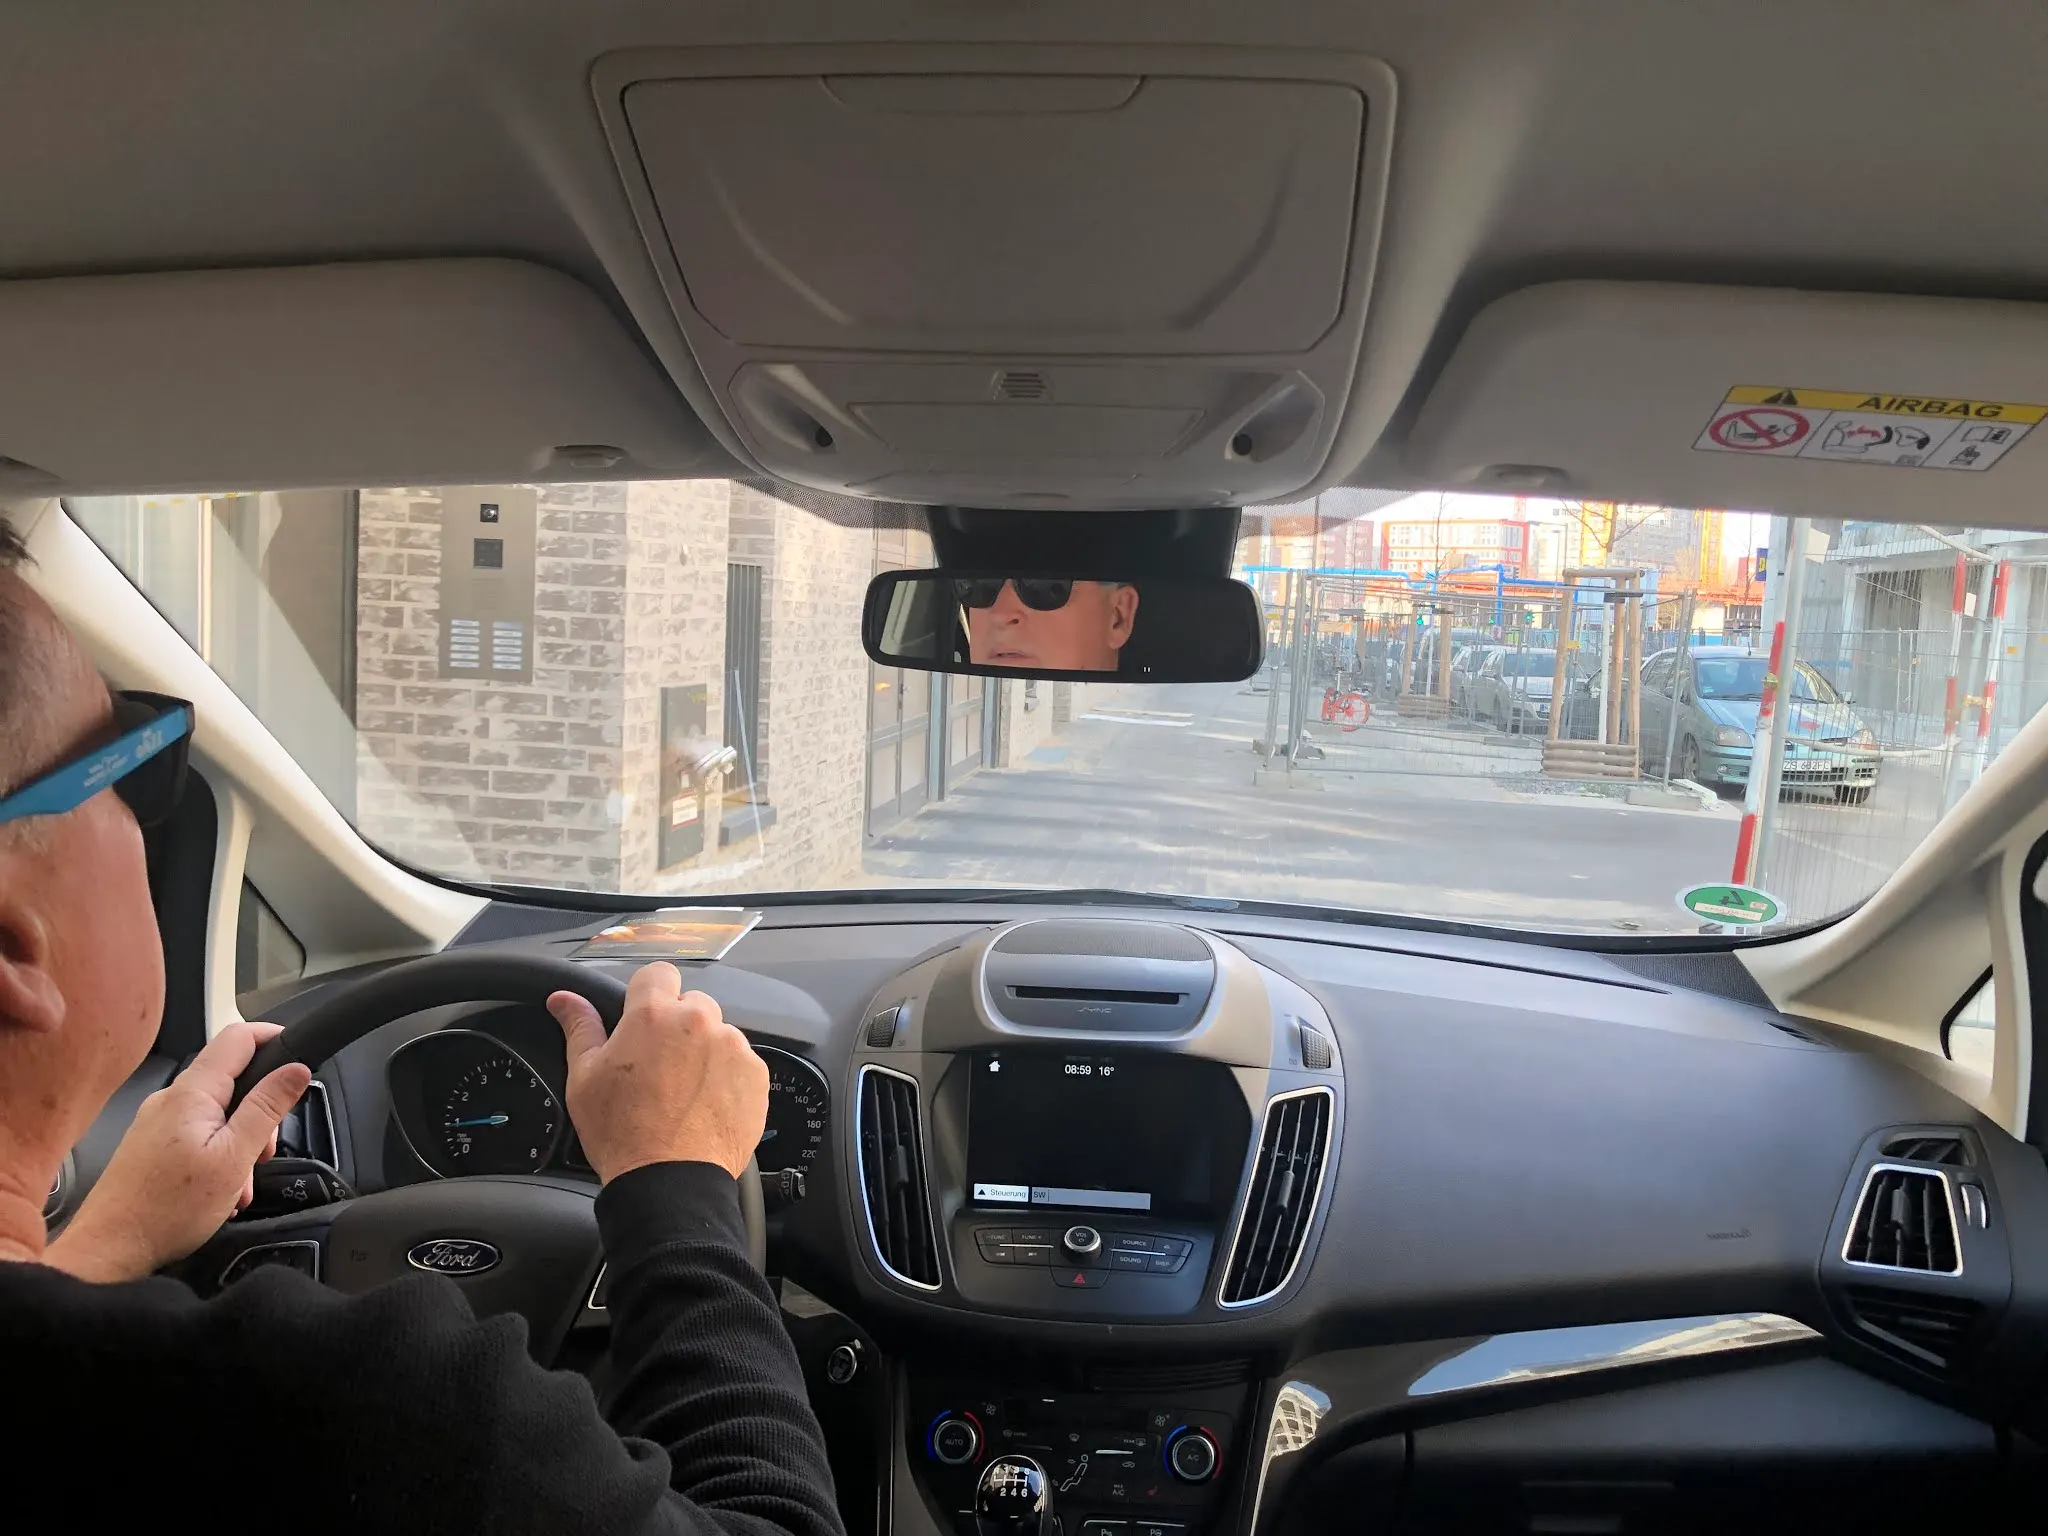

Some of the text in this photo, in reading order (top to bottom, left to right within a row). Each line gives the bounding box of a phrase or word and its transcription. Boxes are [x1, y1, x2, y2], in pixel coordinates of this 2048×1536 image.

[1857, 396, 2005, 419] AIRBAG
[505, 1069, 513, 1079] 4
[1064, 1064, 1115, 1077] 08:59 16°
[480, 1075, 488, 1085] 3
[529, 1078, 537, 1088] 5
[461, 1092, 469, 1101] 2
[794, 1095, 809, 1104] 140
[544, 1097, 552, 1107] 6
[545, 1123, 553, 1134] 7
[806, 1119, 822, 1129] 180
[462, 1143, 470, 1154] 0
[529, 1148, 538, 1158] 8
[990, 1188, 1027, 1199] Steuerung
[1033, 1190, 1047, 1200] SW
[1122, 1239, 1148, 1247] SOURCE
[423, 1242, 481, 1267] Ford
[1119, 1256, 1142, 1264] SOUND
[999, 1487, 1028, 1498] 2 4 6
